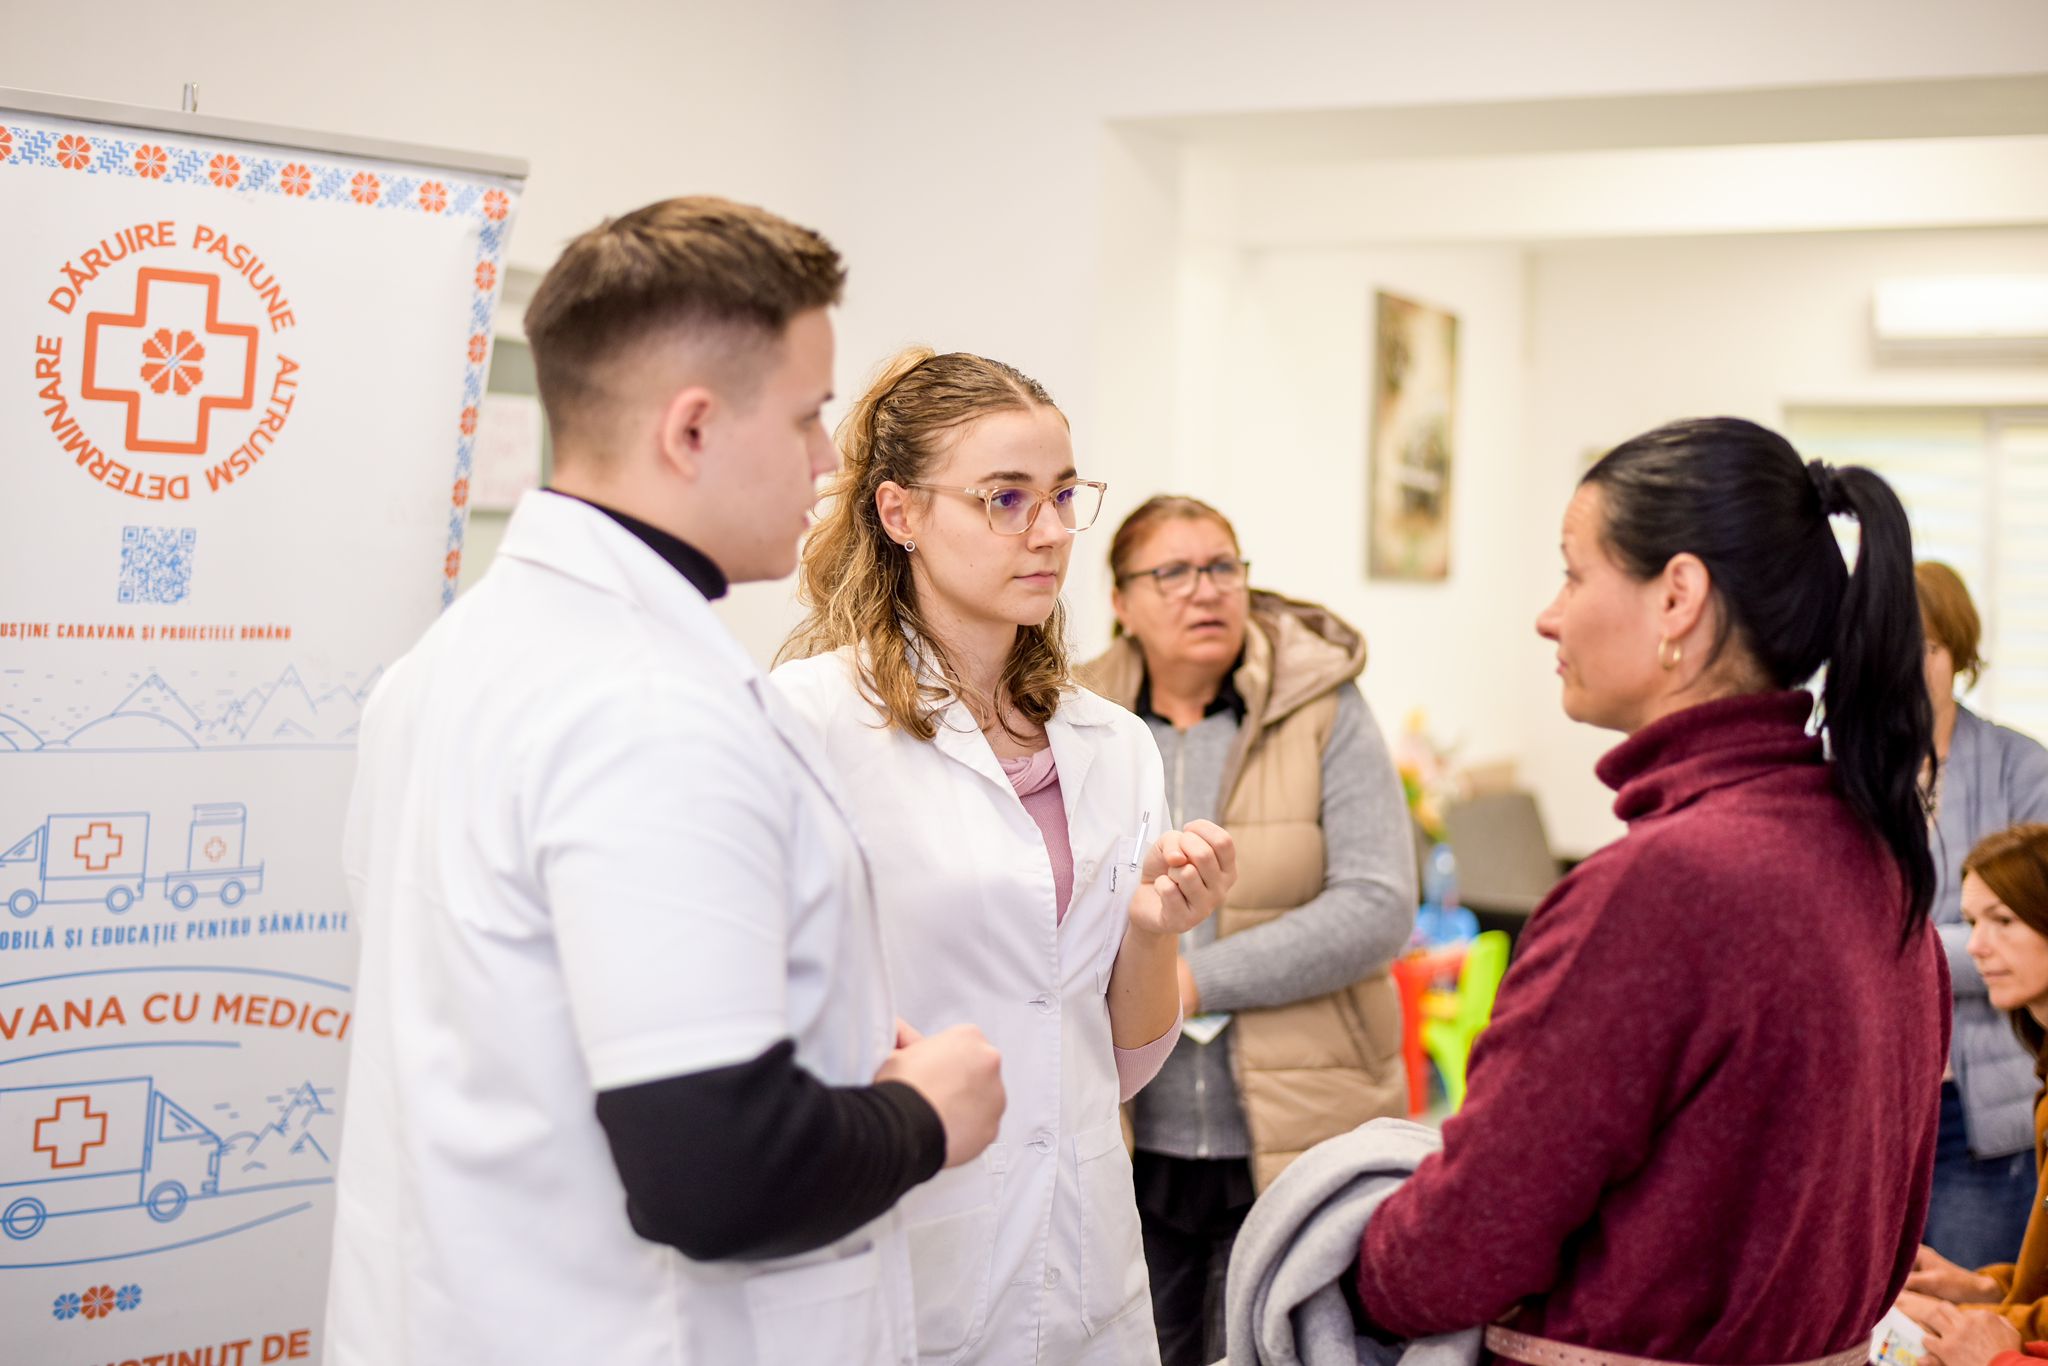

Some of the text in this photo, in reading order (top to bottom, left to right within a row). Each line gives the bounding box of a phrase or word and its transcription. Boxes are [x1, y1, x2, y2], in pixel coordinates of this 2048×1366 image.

[35, 221, 300, 500] DĂRUIRE PASIUNE ALTRUISM DETERMINARE
[57, 623, 135, 640] CARAVANA
[160, 624, 235, 641] PROIECTELE
[65, 928, 83, 949] ȘI
[91, 922, 177, 947] EDUCAȚIE
[187, 917, 250, 940] PENTRU
[258, 911, 347, 934] SĂNĂTATE
[0, 993, 352, 1041] VANA CU MEDICI
[261, 1328, 311, 1364] DE
